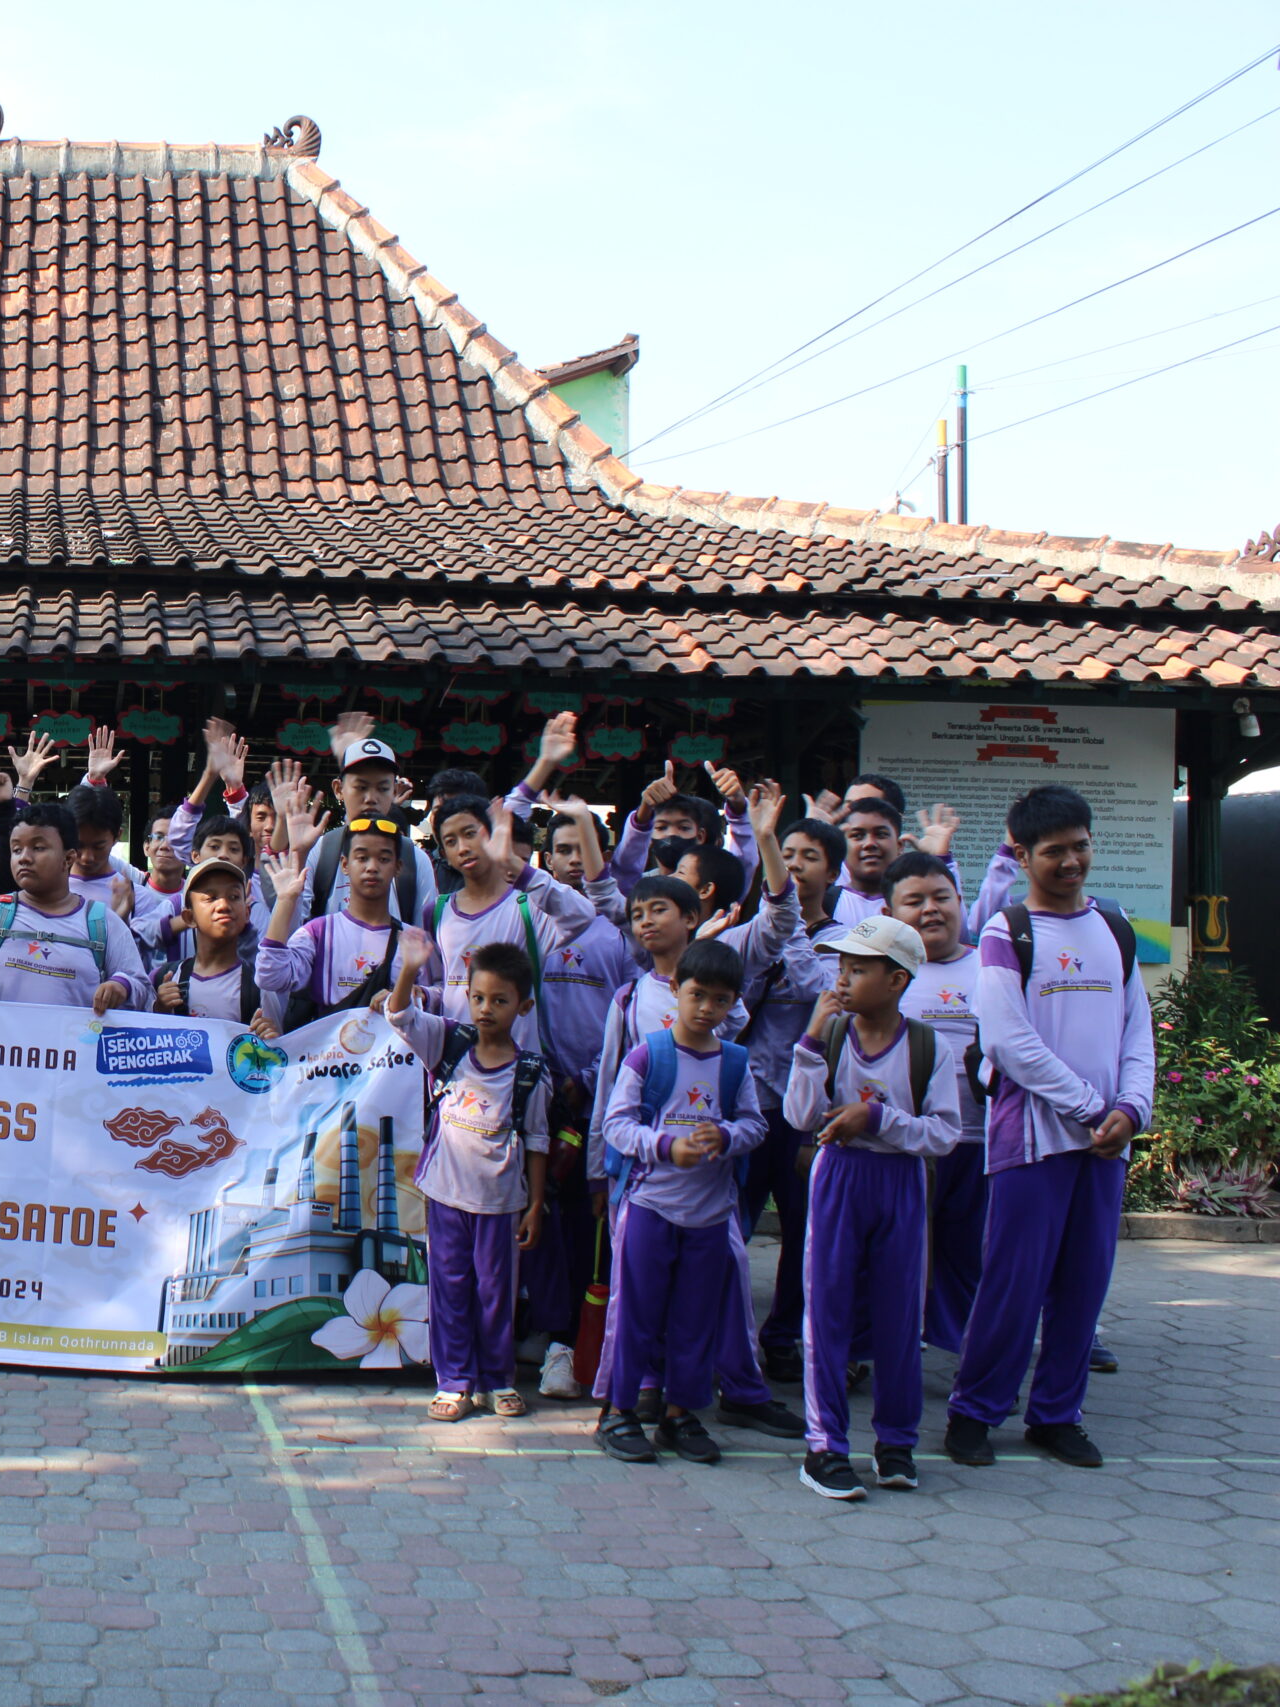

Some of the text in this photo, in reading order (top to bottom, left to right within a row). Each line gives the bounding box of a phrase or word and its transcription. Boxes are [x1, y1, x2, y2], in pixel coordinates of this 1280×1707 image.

[932, 732, 974, 741] Berkarakter
[1082, 737, 1105, 745] Global
[993, 723, 1022, 732] Peserta
[1023, 724, 1041, 733] Didik
[1042, 726, 1061, 735] yang
[107, 1034, 174, 1054] SEKOLAH
[108, 1049, 194, 1071] PENGGERAK
[367, 1044, 415, 1072] satoe
[13, 1331, 54, 1347] Islam
[59, 1335, 156, 1352] Qothrunnada
